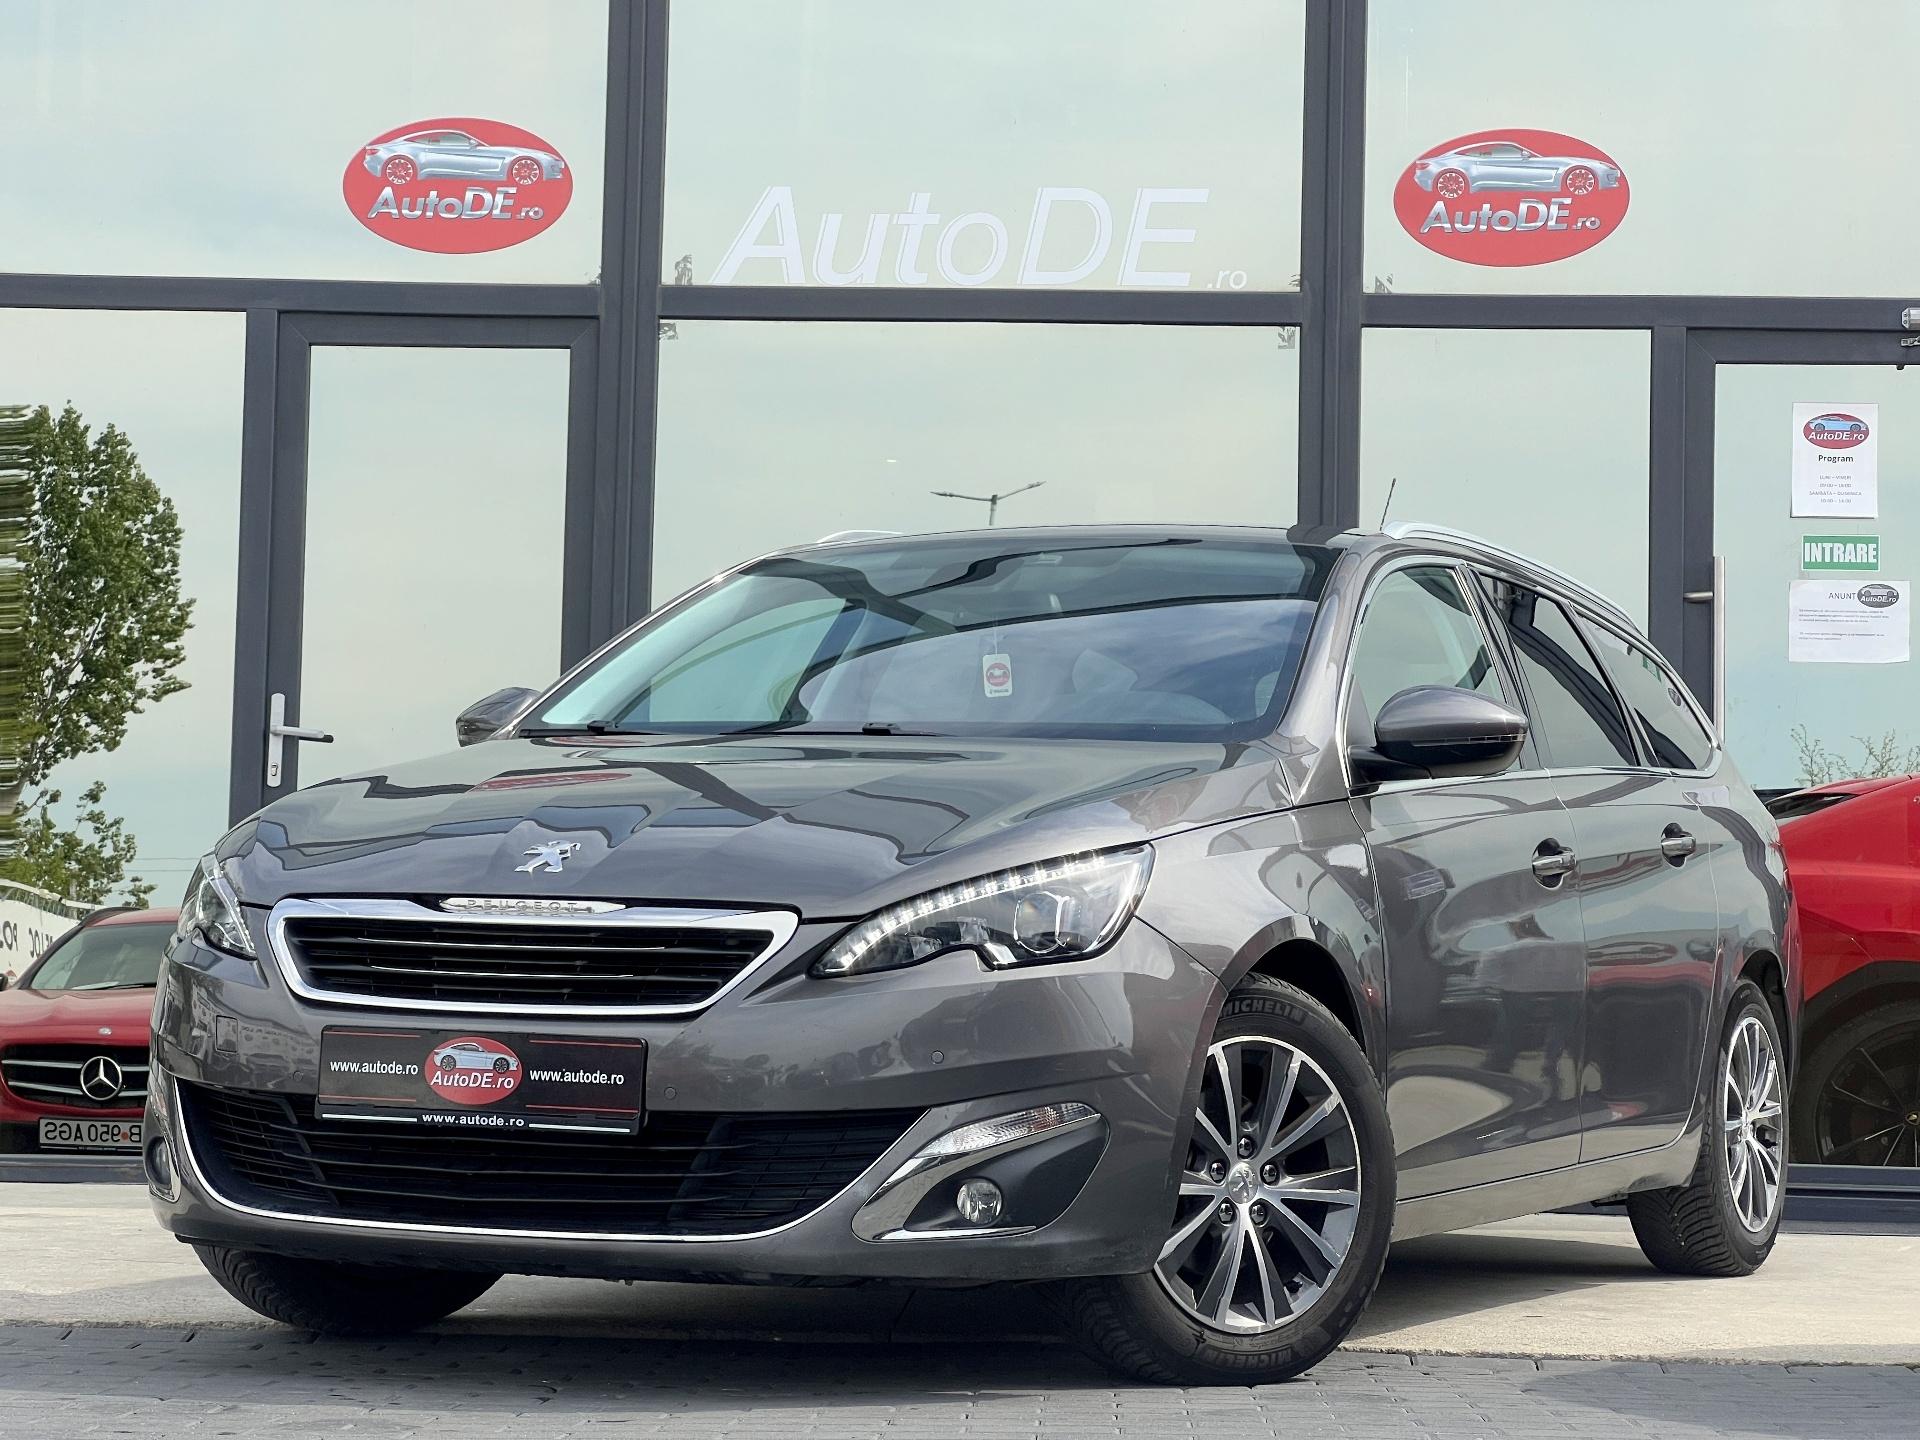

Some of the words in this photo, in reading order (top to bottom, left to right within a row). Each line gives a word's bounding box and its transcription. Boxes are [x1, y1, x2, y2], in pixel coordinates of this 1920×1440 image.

[1808, 431, 1865, 441] AutoDE.ro
[1818, 454, 1854, 464] Program
[1804, 541, 1878, 564] INTRARE
[466, 899, 579, 912] PEUGEOT
[1220, 998, 1304, 1023] MICHELIN
[329, 1059, 419, 1076] www.autode.ro
[430, 1070, 515, 1090] AutoDE.ro
[529, 1068, 625, 1086] www.autode.ro
[422, 1113, 525, 1128] www.autode.ro
